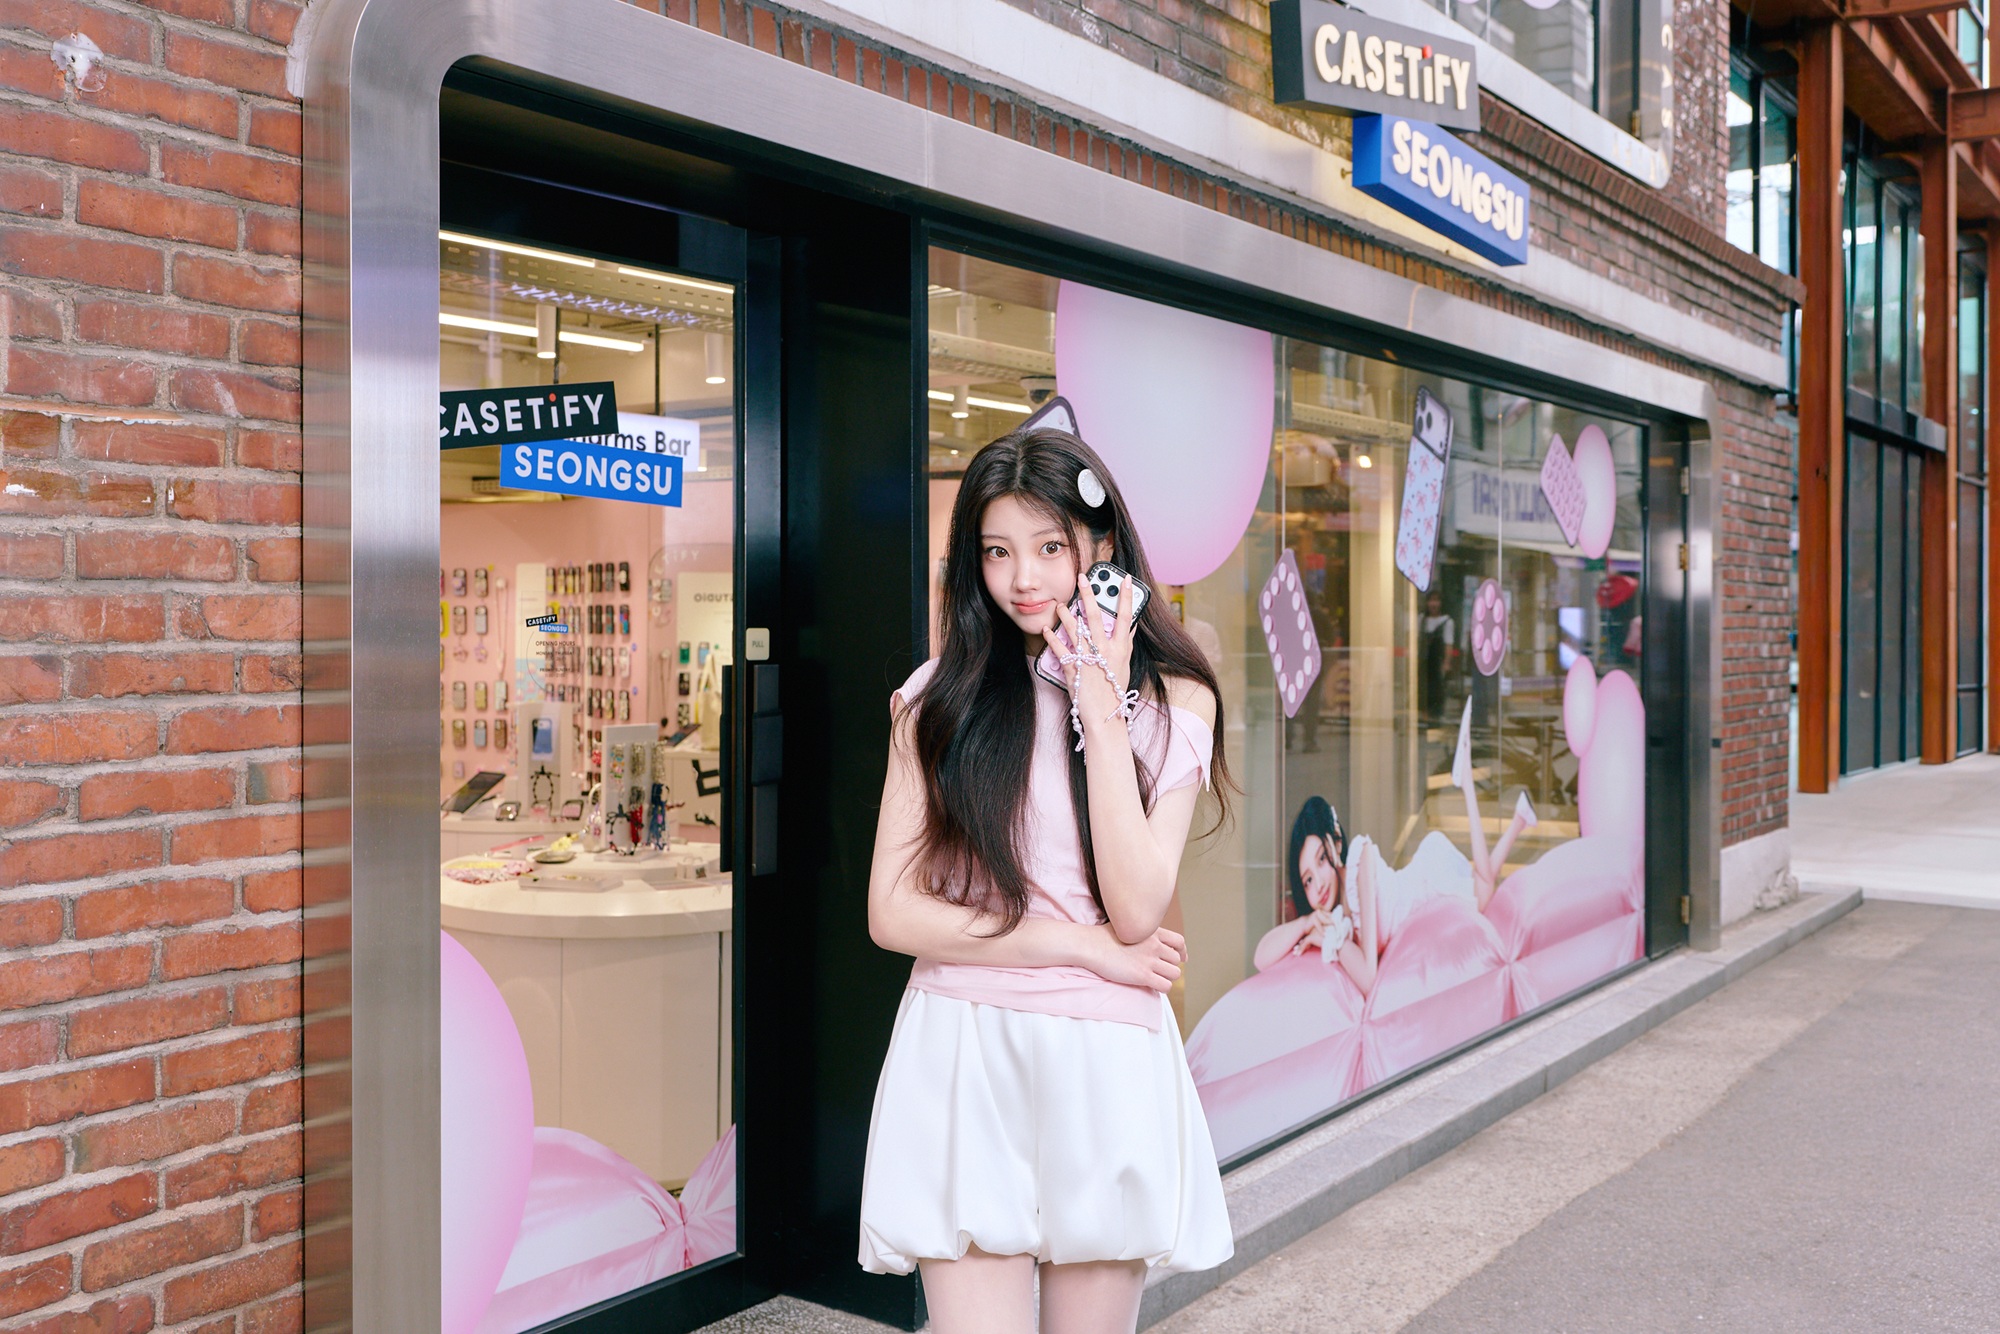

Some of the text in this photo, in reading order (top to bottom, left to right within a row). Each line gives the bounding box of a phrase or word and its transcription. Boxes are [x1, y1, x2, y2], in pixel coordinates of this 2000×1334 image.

[1314, 23, 1471, 111] CASETiFY
[1391, 120, 1524, 241] SEONGSU
[656, 430, 691, 457] Bar
[514, 444, 673, 496] SEONGSU
[752, 640, 765, 648] PULL
